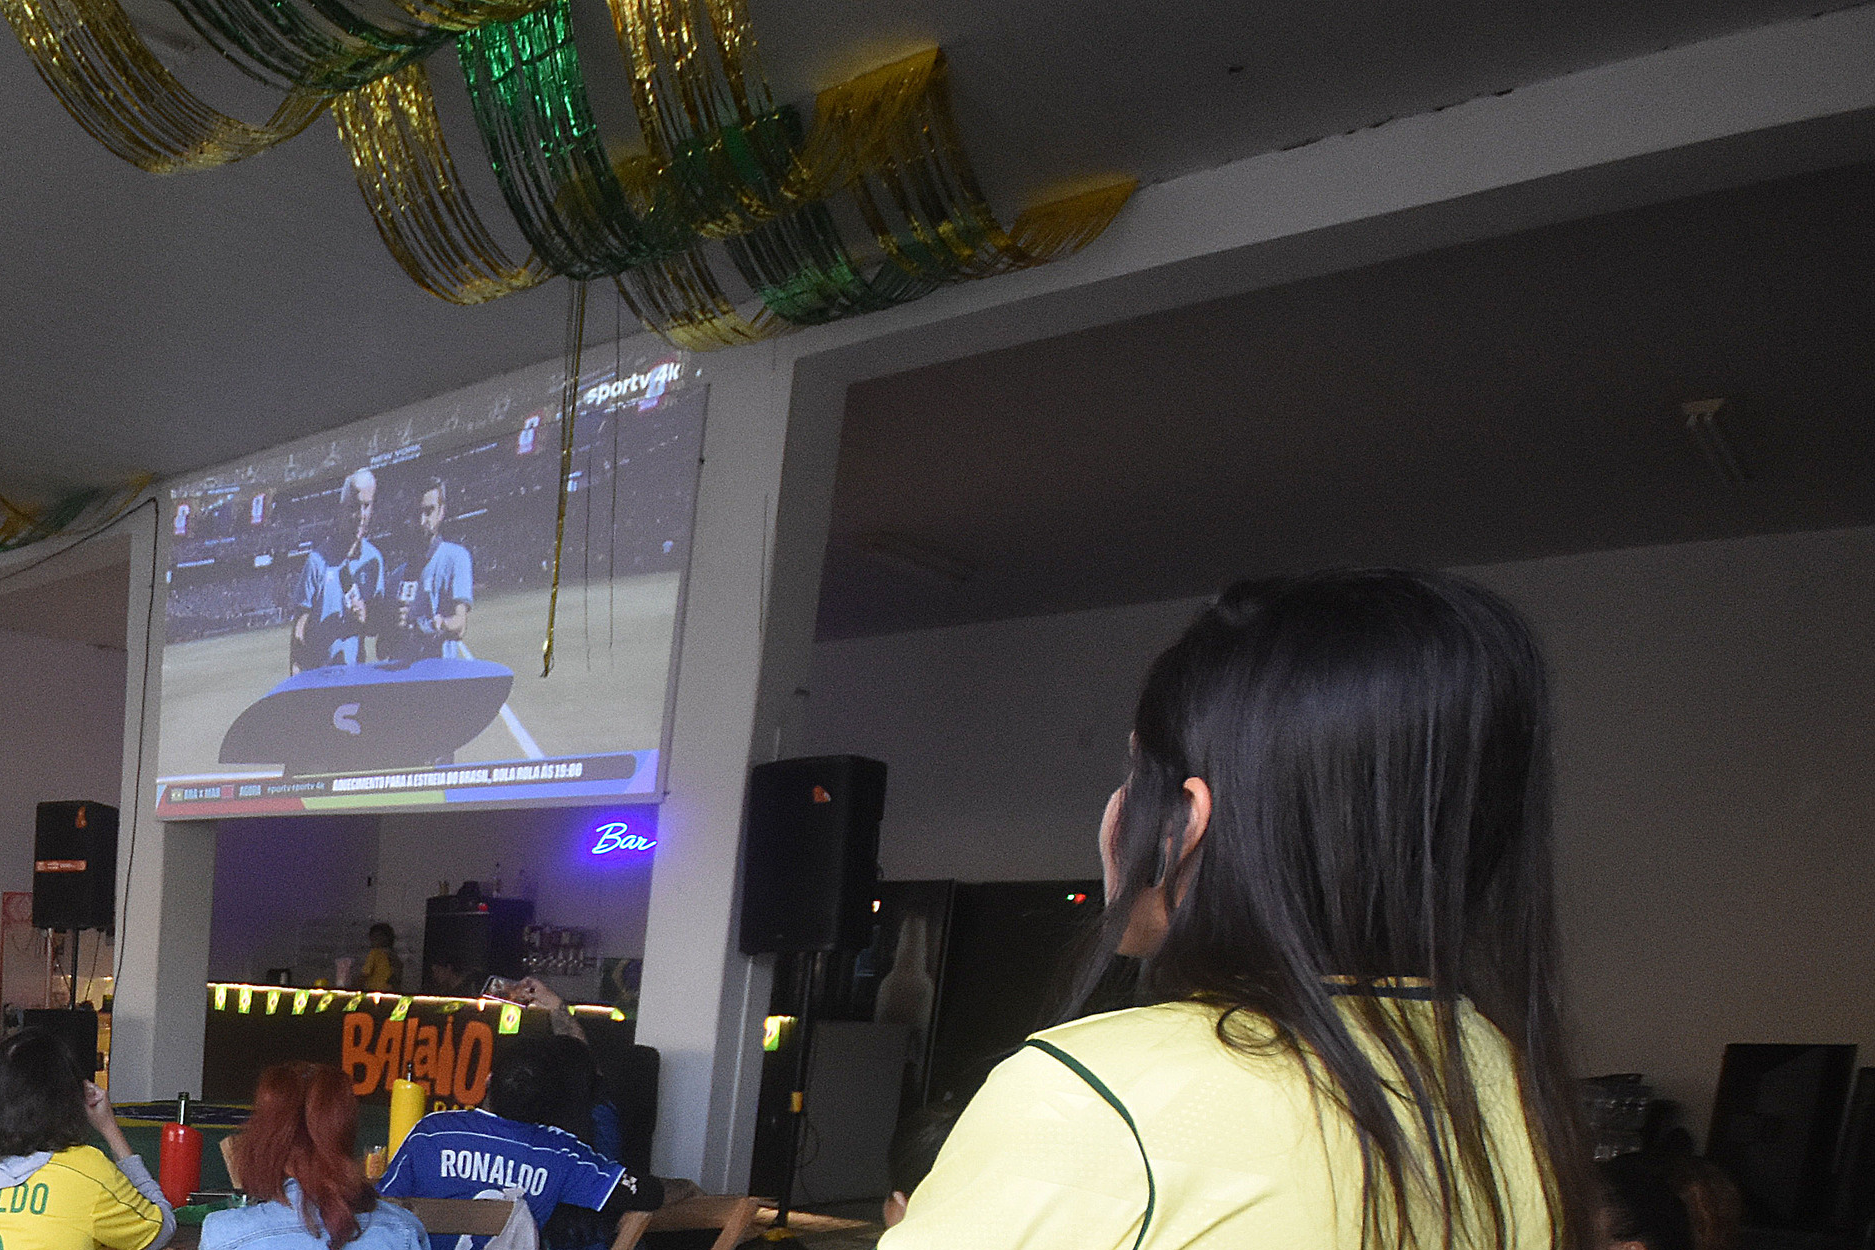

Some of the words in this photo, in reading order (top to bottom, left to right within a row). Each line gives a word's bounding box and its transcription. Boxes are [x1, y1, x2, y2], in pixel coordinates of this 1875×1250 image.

[584, 371, 650, 405] sportv
[591, 821, 658, 855] Bar
[440, 1149, 548, 1196] RONALDO
